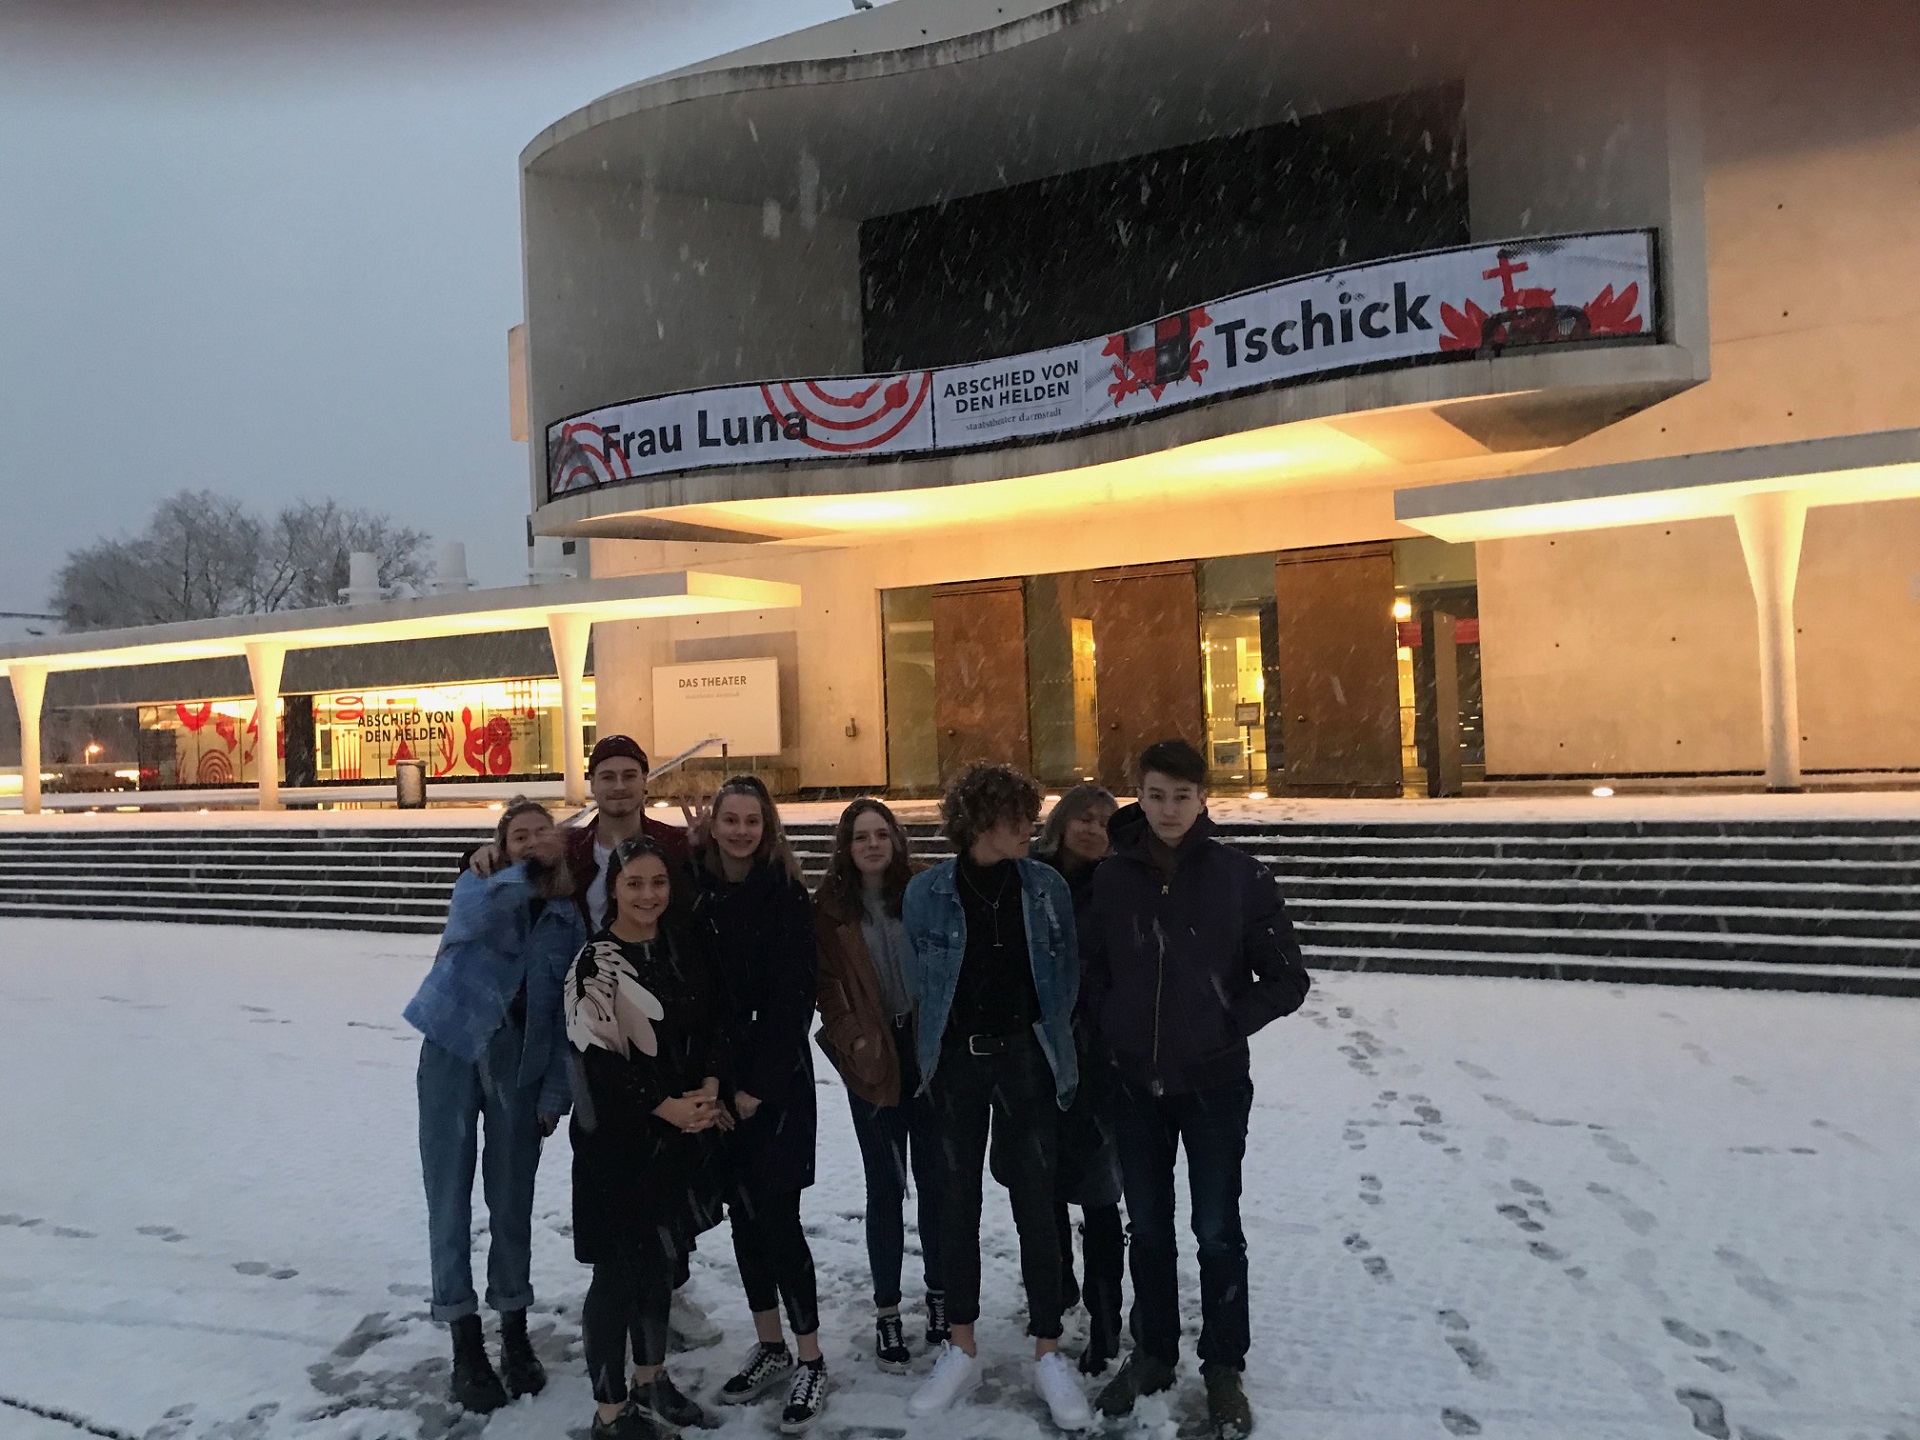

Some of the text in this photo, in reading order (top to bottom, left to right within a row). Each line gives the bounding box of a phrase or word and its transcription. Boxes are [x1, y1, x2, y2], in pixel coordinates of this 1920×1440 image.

[1215, 281, 1433, 368] Tschick
[944, 360, 1078, 398] ABSCHIED VON
[956, 380, 1069, 413] DEN HELDEN
[602, 409, 809, 464] Frau Luna
[679, 675, 747, 688] DAS THEATER
[358, 711, 454, 727] ABSCHIED VON
[365, 726, 447, 742] DEN HELDEN
